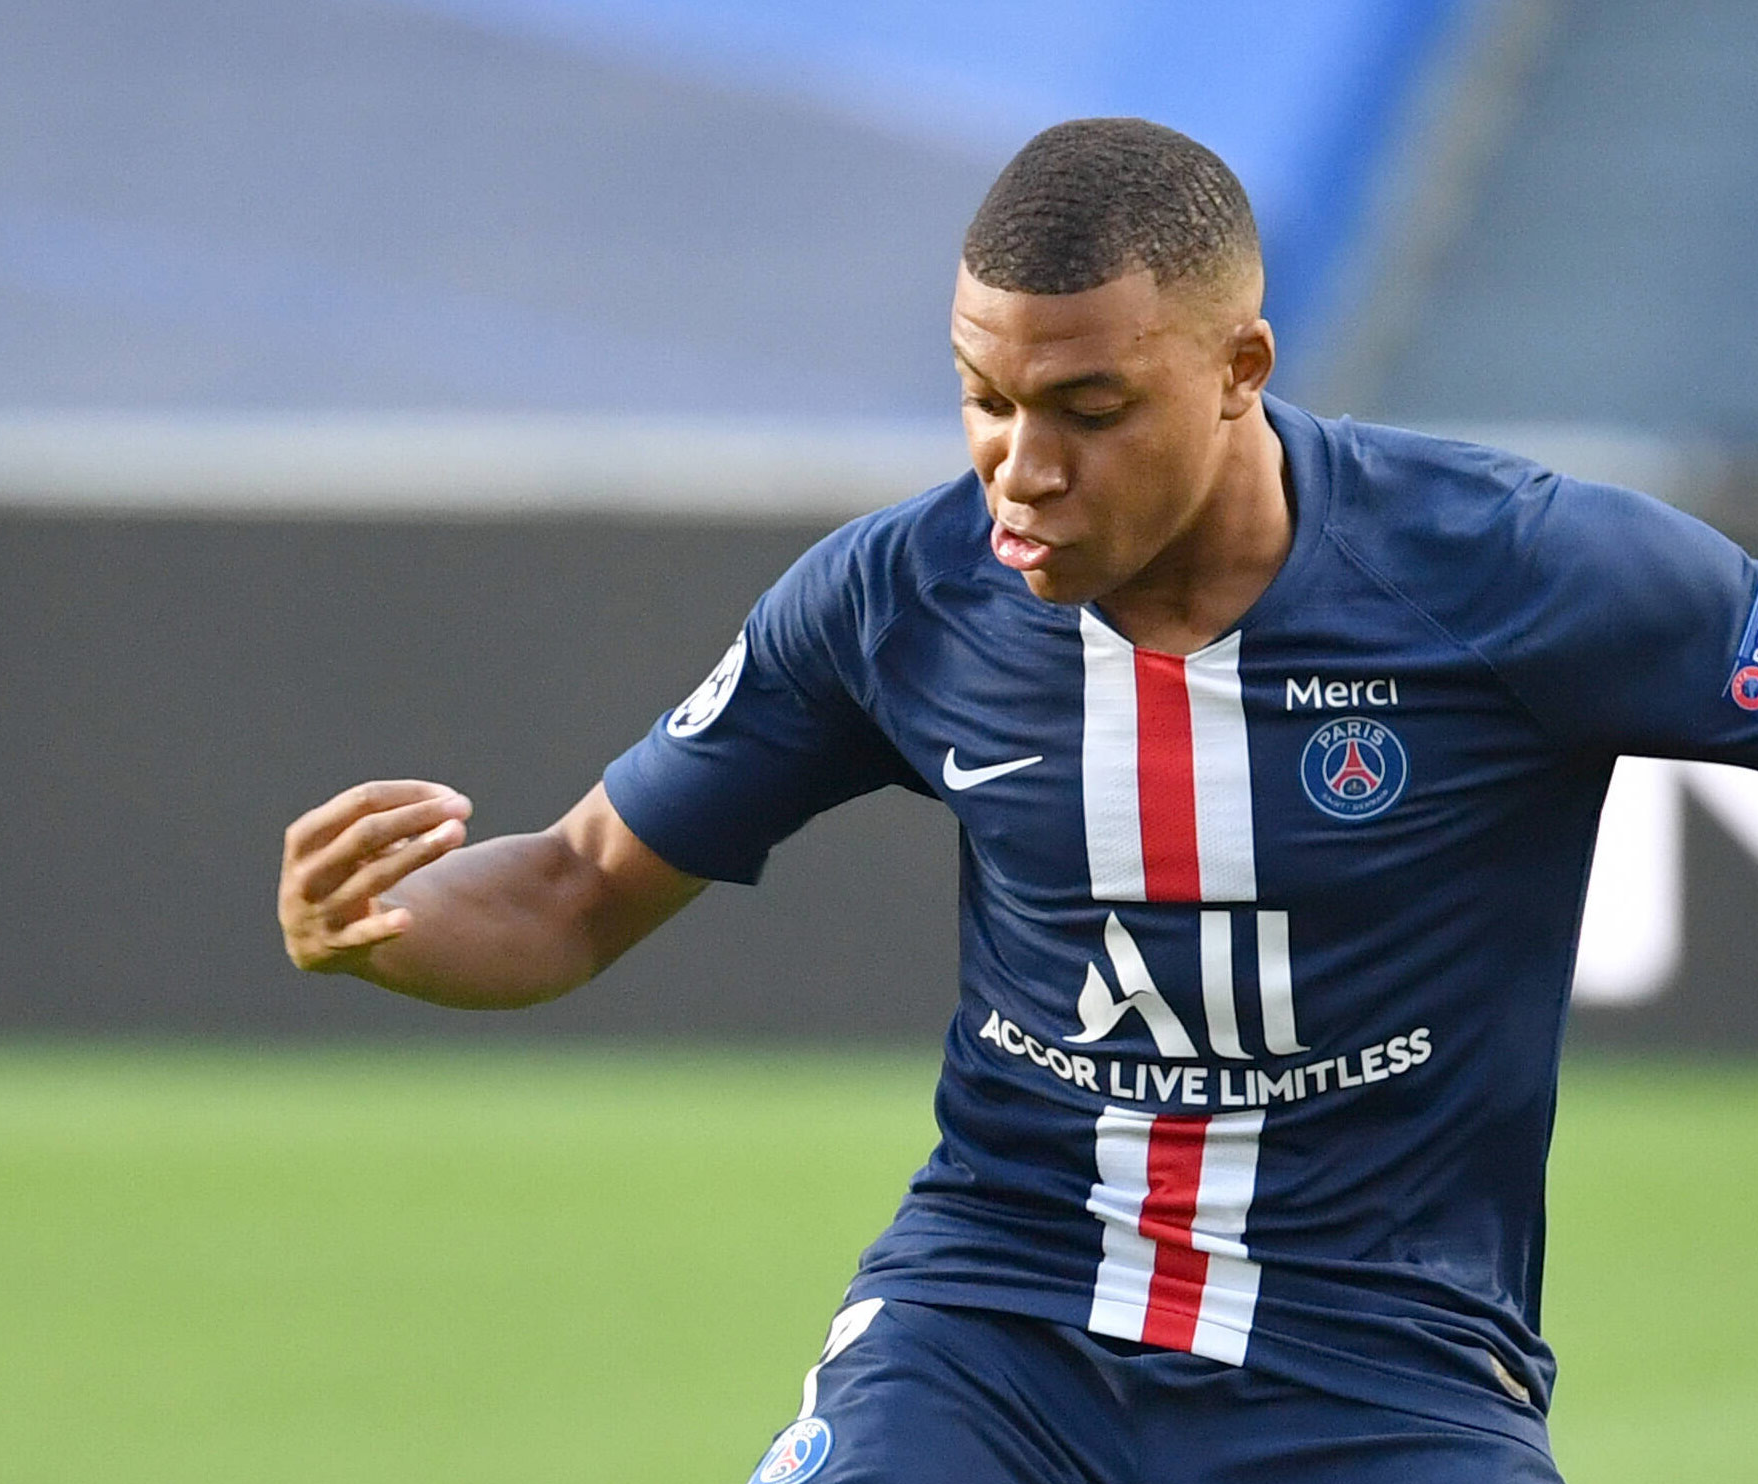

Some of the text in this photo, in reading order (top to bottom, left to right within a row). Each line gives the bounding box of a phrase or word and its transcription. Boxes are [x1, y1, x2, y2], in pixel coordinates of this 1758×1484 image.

[1286, 676, 1399, 711] Merci
[1317, 721, 1386, 749] PARIS
[978, 1010, 1433, 1106] ACCOR LIVE LIMITLESS
